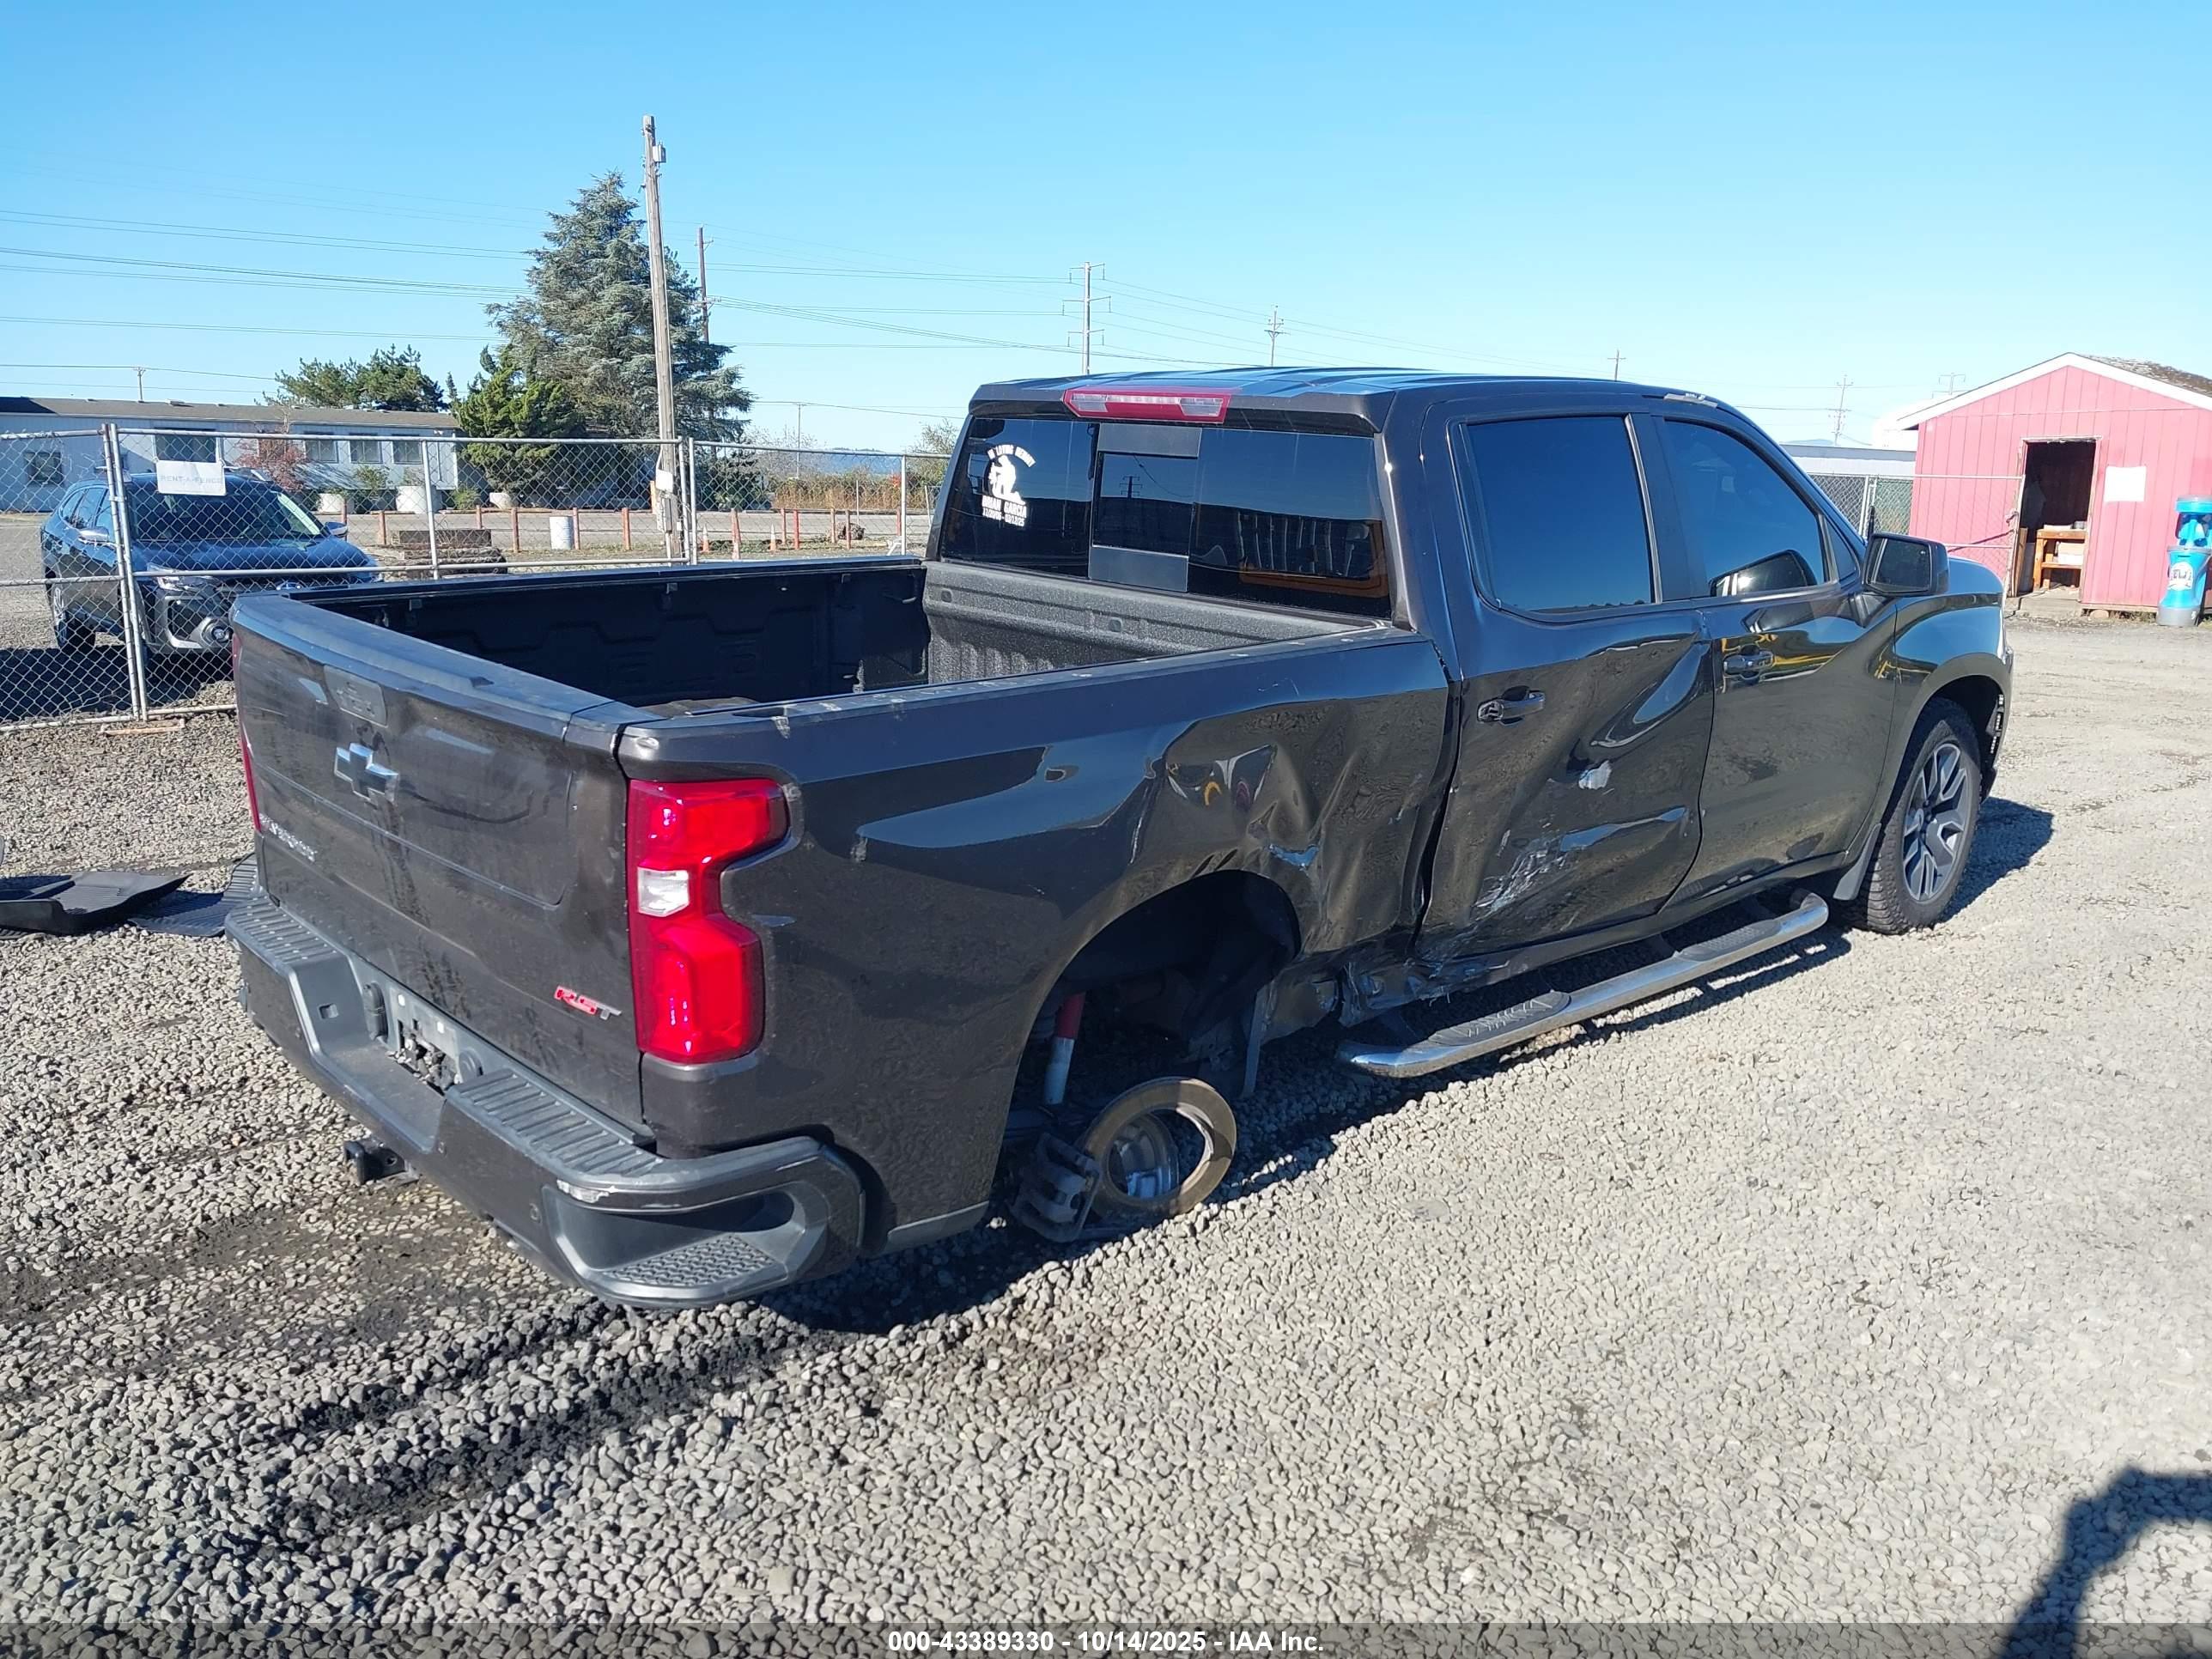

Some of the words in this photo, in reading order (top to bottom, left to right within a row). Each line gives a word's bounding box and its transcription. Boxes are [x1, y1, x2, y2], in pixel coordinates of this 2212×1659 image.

[981, 495, 1002, 511] BRIAN
[1004, 501, 1027, 519] GARCIA
[554, 985, 622, 1021] RST
